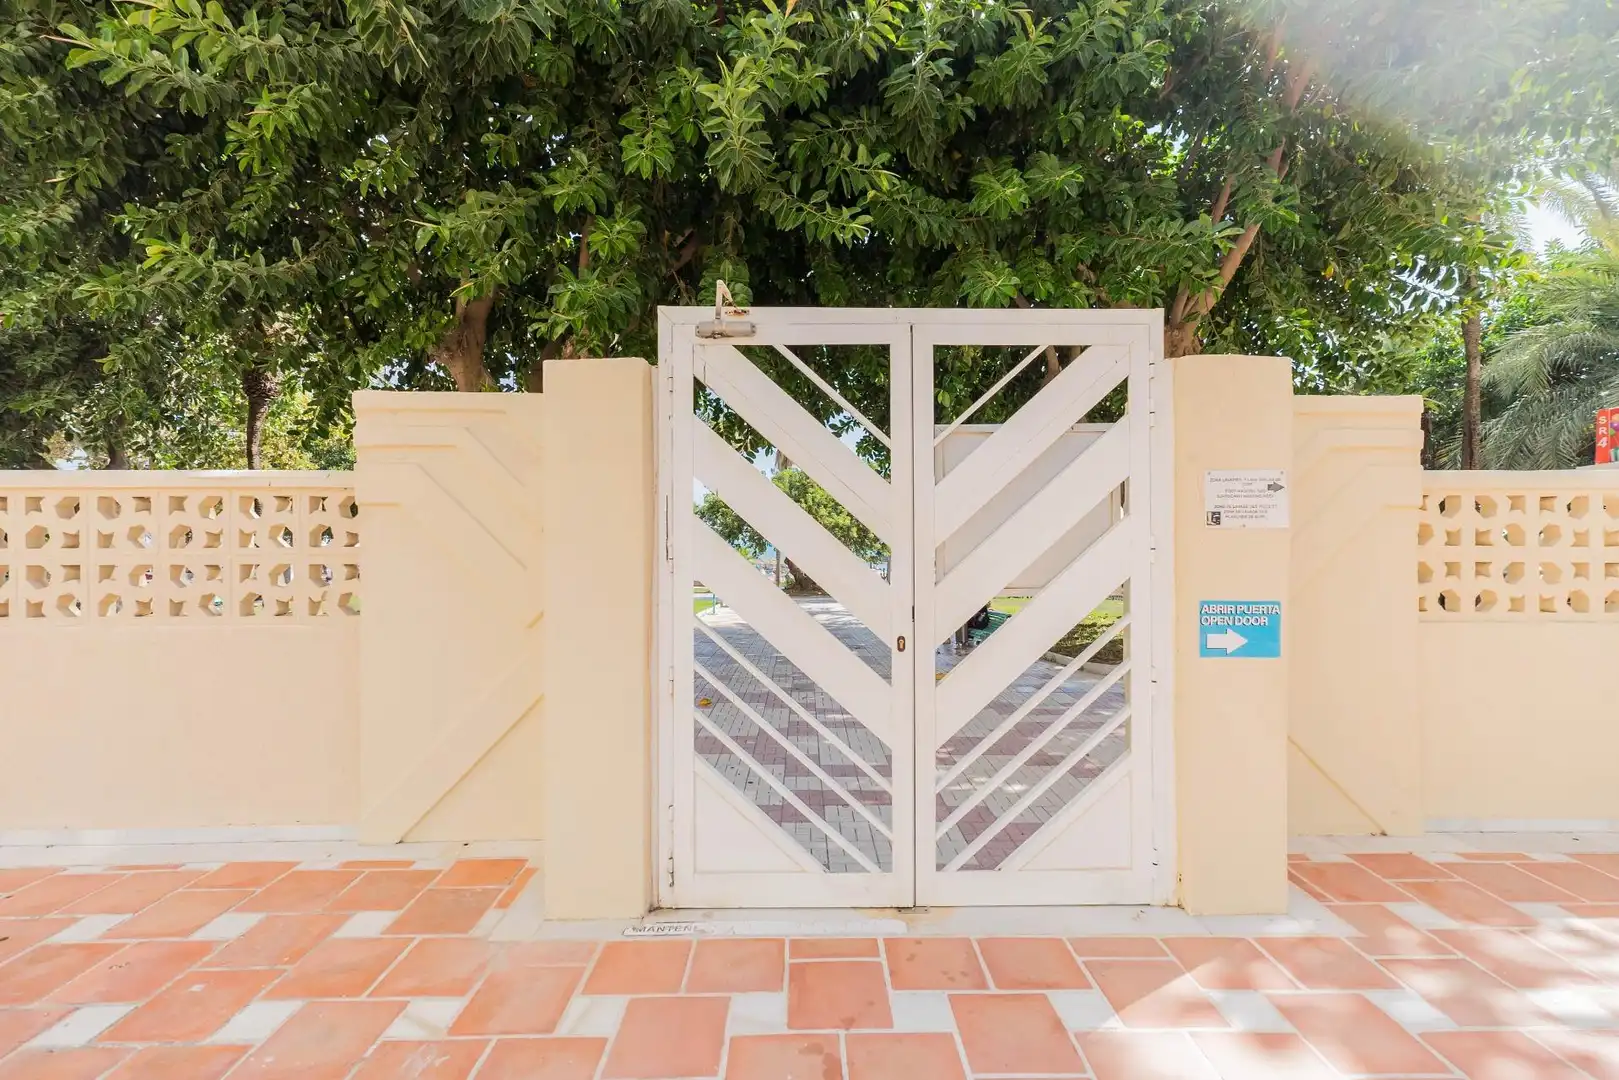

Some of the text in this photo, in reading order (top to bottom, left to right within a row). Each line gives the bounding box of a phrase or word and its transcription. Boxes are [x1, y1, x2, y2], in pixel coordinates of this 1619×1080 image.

[1201, 604, 1280, 614] ABRIR PUERTA
[1201, 616, 1268, 626] OPEN DOOR
